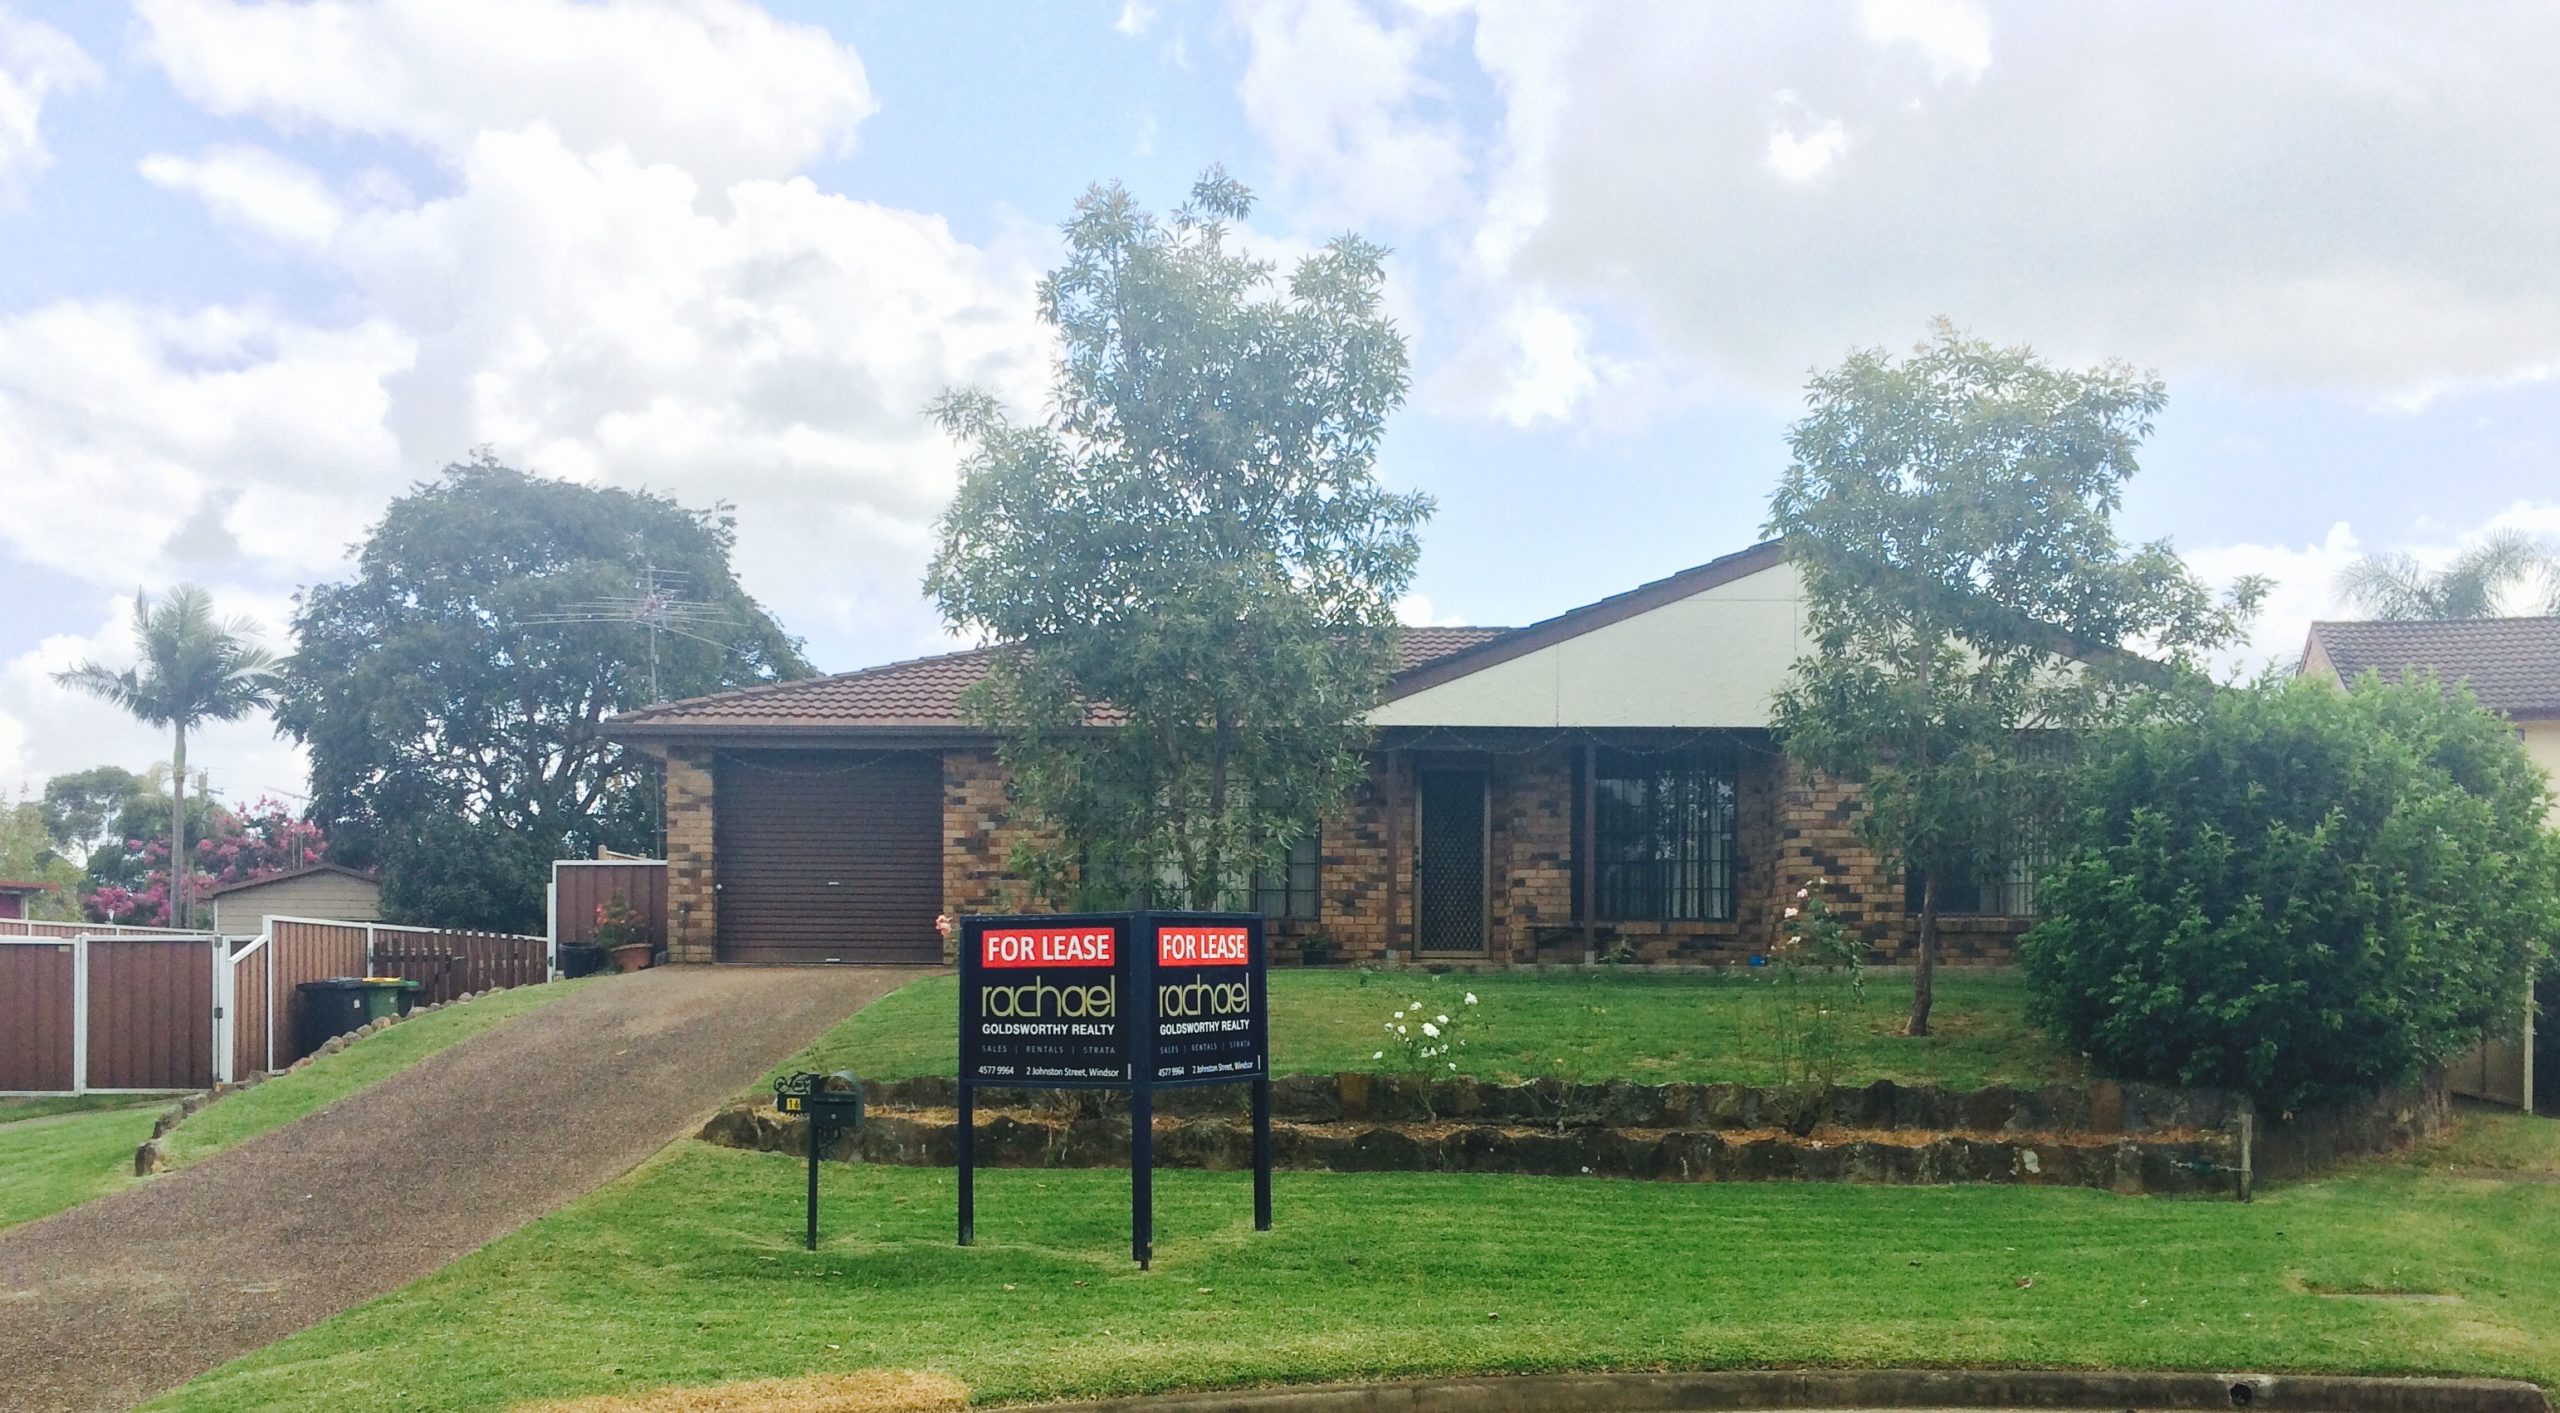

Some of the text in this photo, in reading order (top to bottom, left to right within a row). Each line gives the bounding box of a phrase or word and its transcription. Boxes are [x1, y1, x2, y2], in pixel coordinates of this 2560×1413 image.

[988, 934, 1110, 961] FOR LEASE
[1162, 934, 1246, 960] FOR LEASE
[982, 974, 1116, 1018] rachael
[1159, 972, 1250, 1018] rachael
[982, 1023, 1115, 1036] GOLDSWORTHY REALTY
[1160, 1019, 1250, 1035] GOLDSWORTHY REALTY
[982, 1045, 1116, 1054] SALES RENTALS STRATA
[978, 1066, 1119, 1078] 4577 9964 2 Johnston Street, Windsor
[1158, 1067, 1171, 1077] 4577
[1171, 1067, 1185, 1076] 9964
[1192, 1065, 1196, 1074] 2
